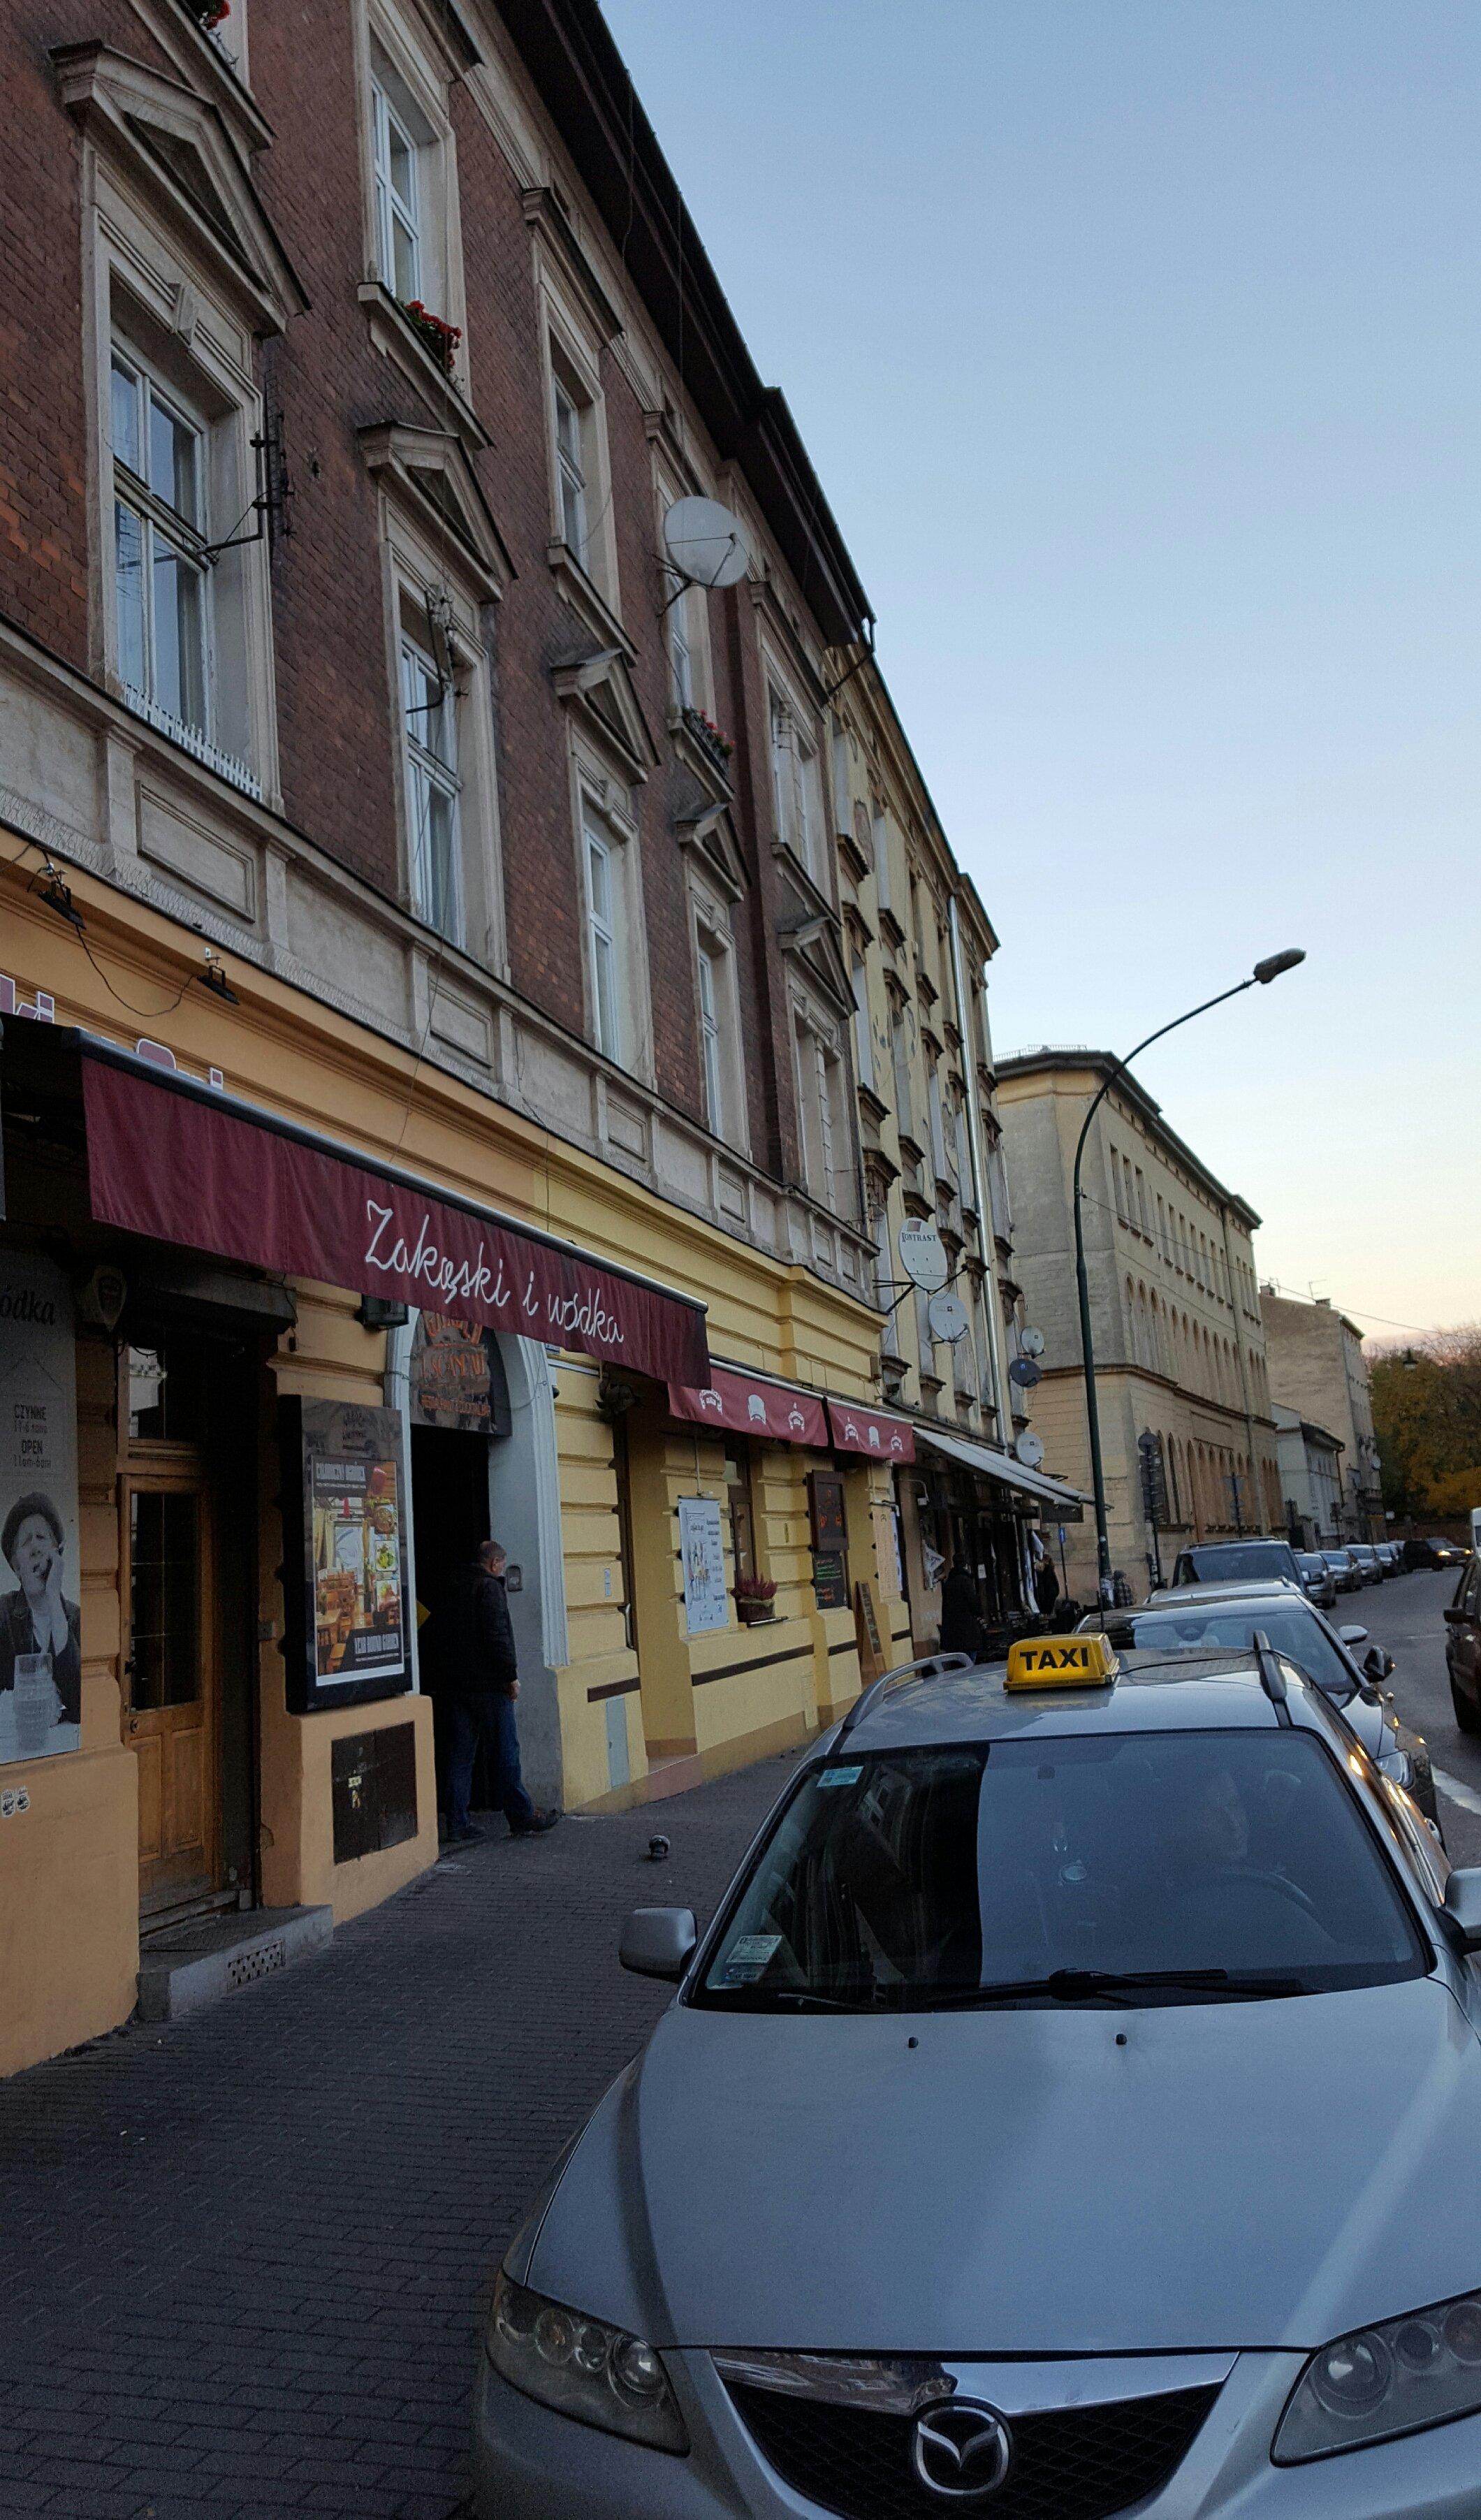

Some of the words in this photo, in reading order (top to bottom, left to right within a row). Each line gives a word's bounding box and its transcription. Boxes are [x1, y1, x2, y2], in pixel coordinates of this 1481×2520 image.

[901, 1232, 937, 1242] KONTRAST
[365, 1200, 511, 1307] Zakąski
[523, 1270, 539, 1316] i
[548, 1287, 625, 1344] wódka
[14, 1404, 47, 1420] CZYNNE
[21, 1439, 43, 1455] OPEN
[1019, 1647, 1089, 1671] TAXI
